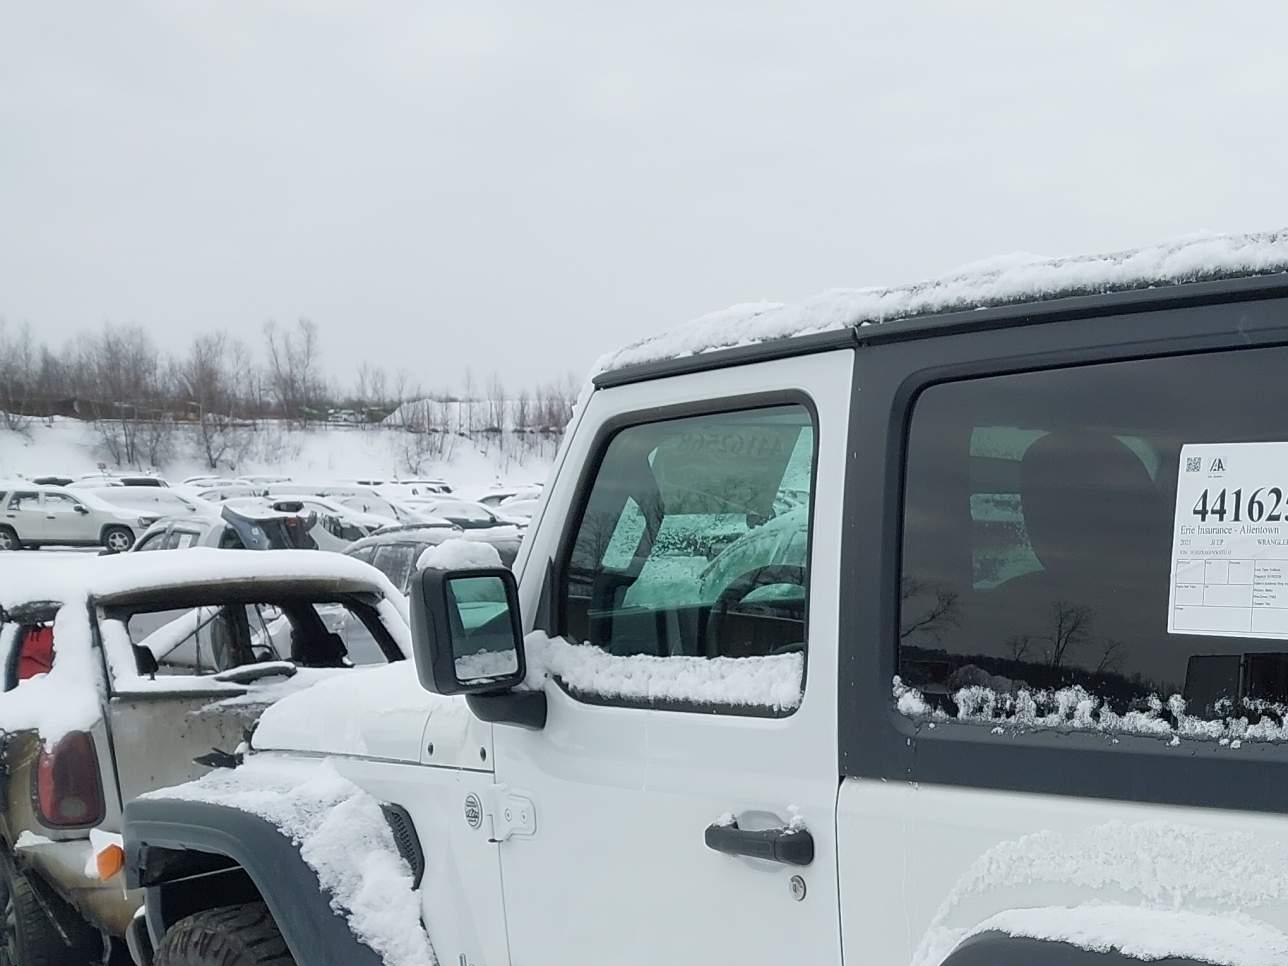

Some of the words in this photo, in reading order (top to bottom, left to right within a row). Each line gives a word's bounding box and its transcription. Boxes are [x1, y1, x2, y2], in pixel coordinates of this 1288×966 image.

[1180, 525, 1196, 535] Erie
[1198, 525, 1232, 535] Insurance
[1240, 525, 1280, 535] Allentown
